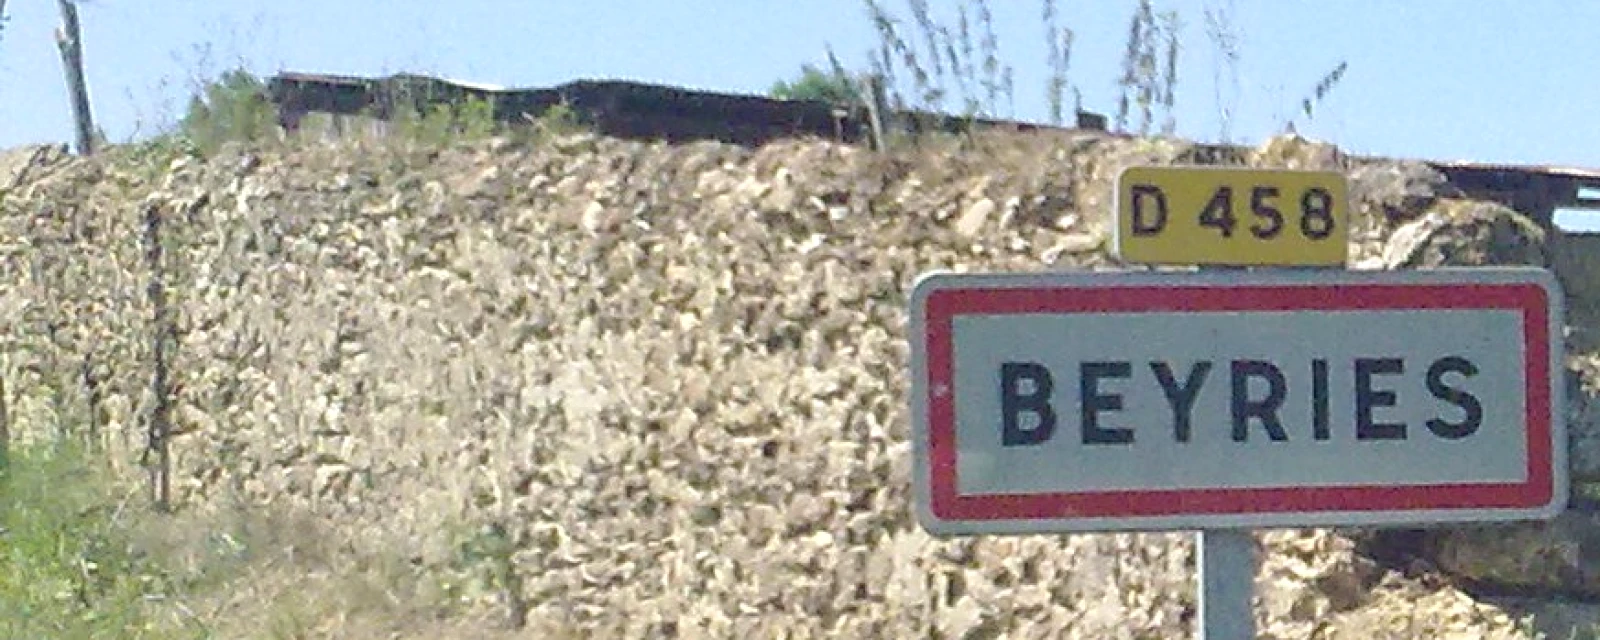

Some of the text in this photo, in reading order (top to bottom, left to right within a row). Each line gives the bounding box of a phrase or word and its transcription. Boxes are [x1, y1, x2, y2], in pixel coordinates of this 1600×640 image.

[1131, 185, 1336, 240] D 458
[999, 356, 1484, 448] BEYRIES
